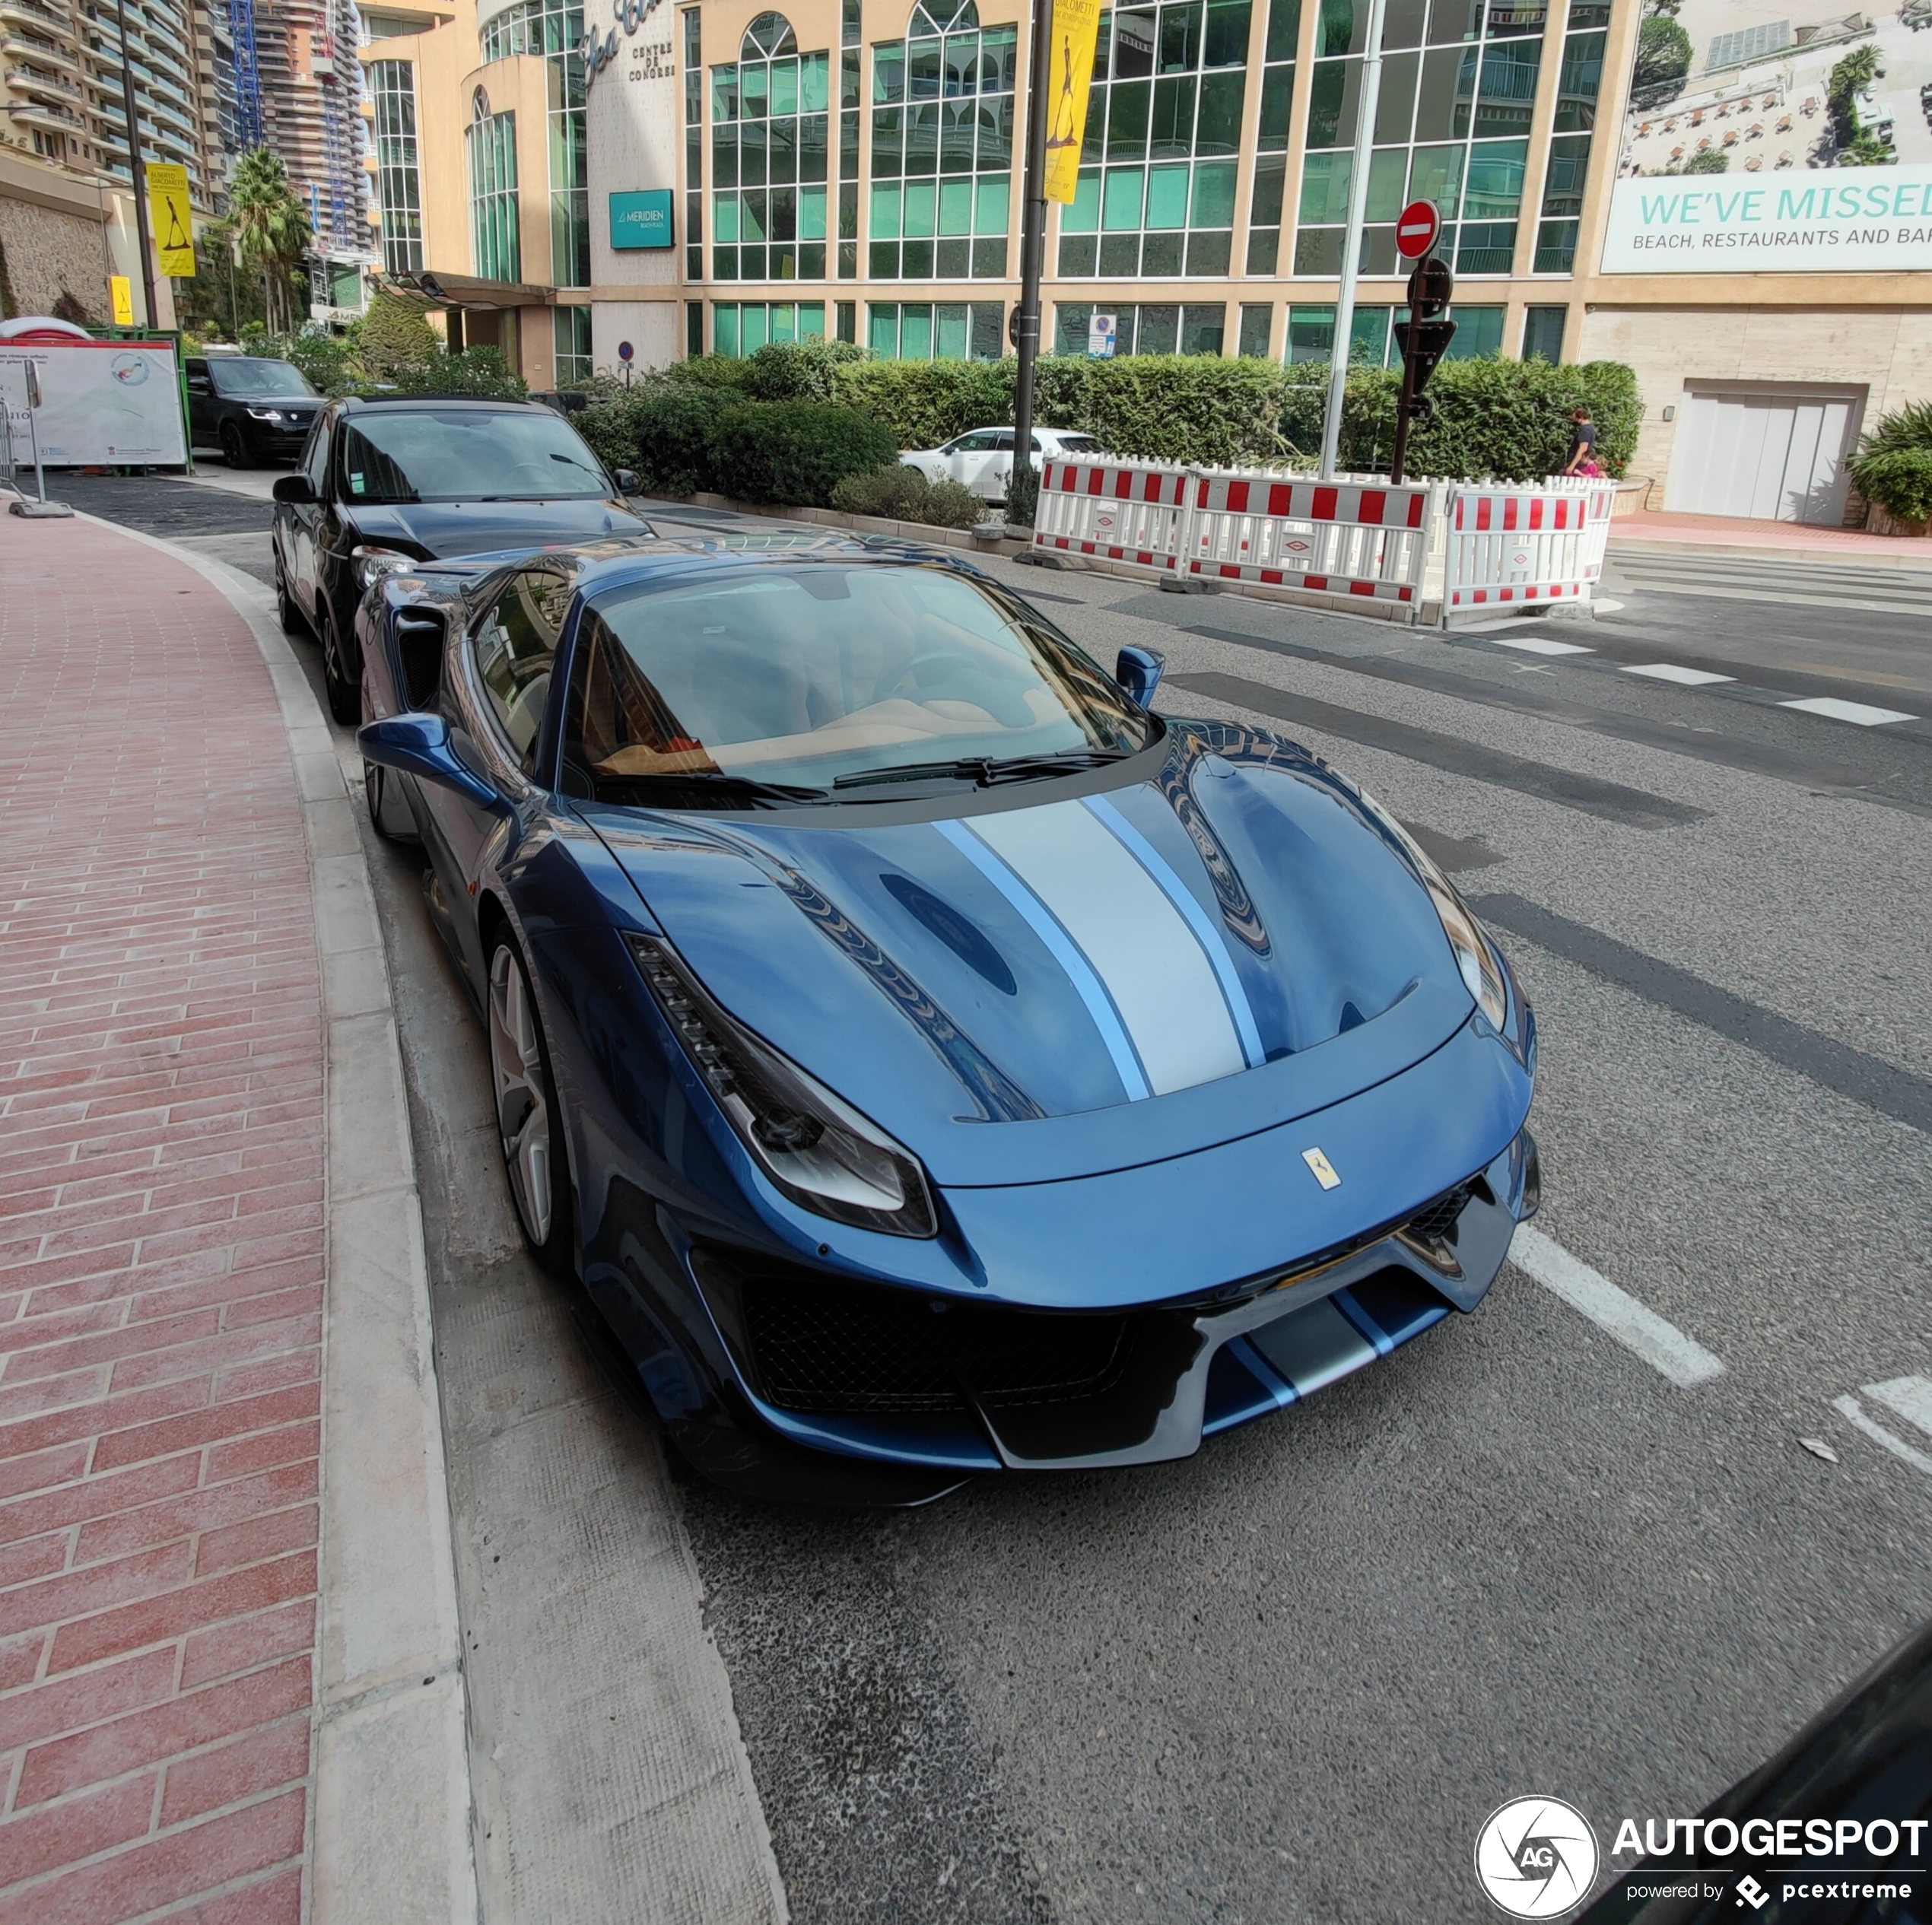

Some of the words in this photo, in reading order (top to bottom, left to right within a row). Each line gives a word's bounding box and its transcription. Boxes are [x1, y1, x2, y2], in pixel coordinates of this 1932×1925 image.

[632, 42, 672, 59] CENTRE
[646, 56, 659, 68] DE
[1640, 190, 1765, 225] WE'VE
[627, 210, 664, 223] MERIDIEN
[1633, 233, 1695, 249] BEACH,
[1702, 230, 1839, 248] RESTAURANTS
[1846, 229, 1890, 245] AND
